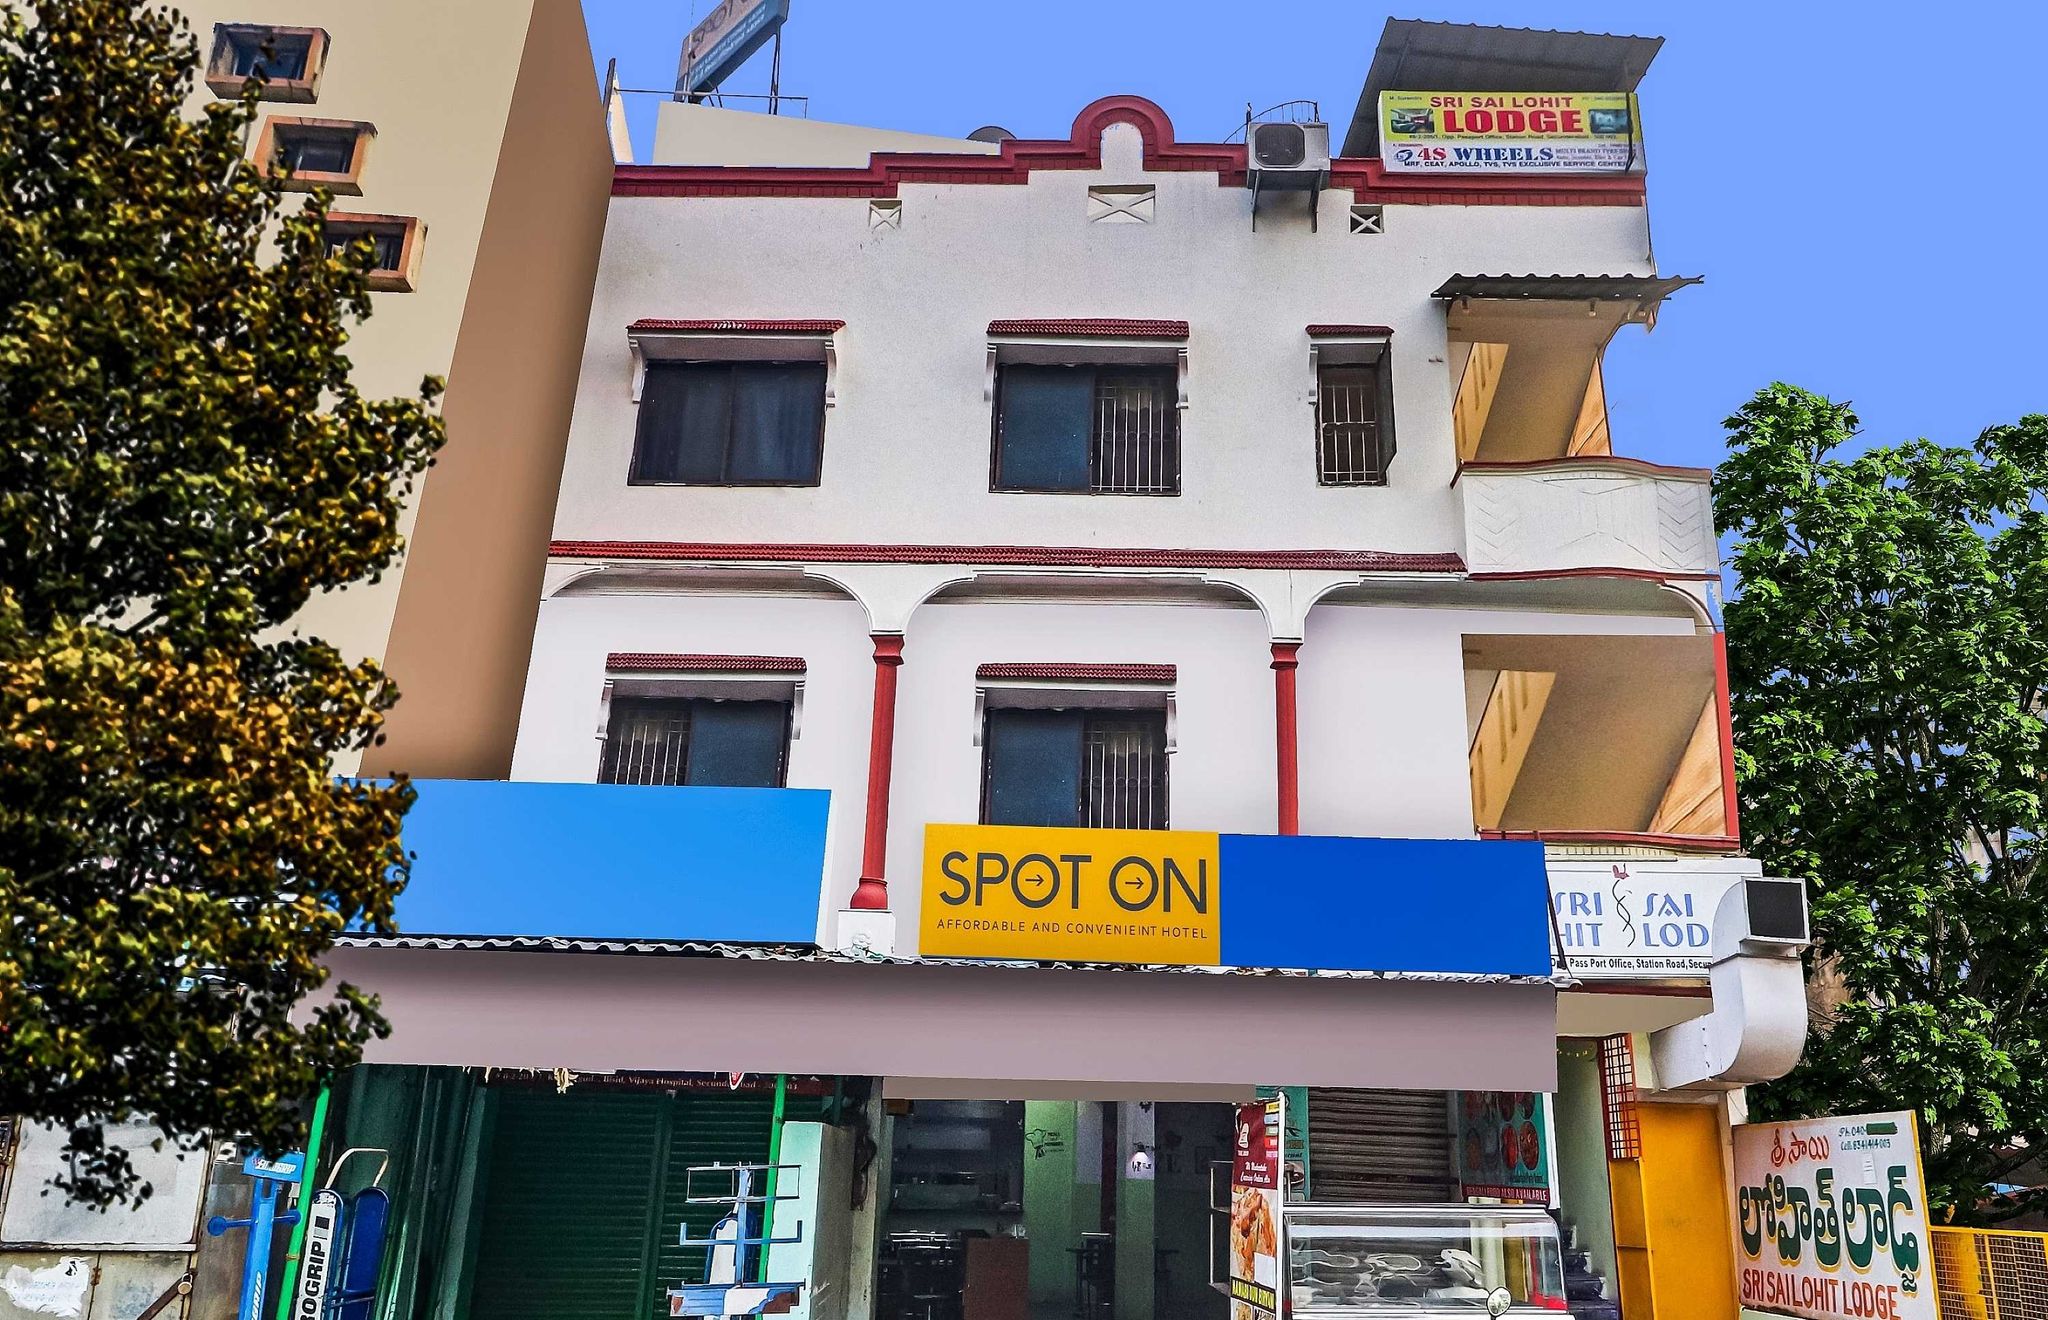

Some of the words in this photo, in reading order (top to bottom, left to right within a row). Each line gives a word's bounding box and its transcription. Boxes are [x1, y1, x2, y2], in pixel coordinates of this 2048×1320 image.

[1430, 96, 1464, 108] SRI
[1471, 96, 1504, 108] SAI
[1512, 97, 1573, 108] LOHIT
[1443, 109, 1584, 133] LODGE
[1417, 147, 1447, 161] 4S
[1453, 147, 1554, 161] WHEELS
[939, 851, 1092, 909] SPOT
[1108, 855, 1207, 914] ON
[1554, 892, 1603, 916] SRI
[1642, 893, 1694, 917] SAI
[936, 918, 1026, 932] AFFORDABLE
[1031, 922, 1060, 933] AND
[1161, 927, 1208, 939] HOTEL
[1569, 957, 1588, 968] Pass
[1590, 958, 1607, 968] Port
[1608, 958, 1635, 971] Office,
[1636, 958, 1664, 969] Station
[1770, 1128, 1786, 1167] శ్రీ
[1788, 1131, 1830, 1165] సాయి
[1515, 1188, 1547, 1201] AVAILABLE
[1742, 1268, 1764, 1301] SRI
[1766, 1271, 1790, 1306] SAI
[1792, 1276, 1839, 1313] LOHIT
[1842, 1280, 1904, 1320] LODGE
